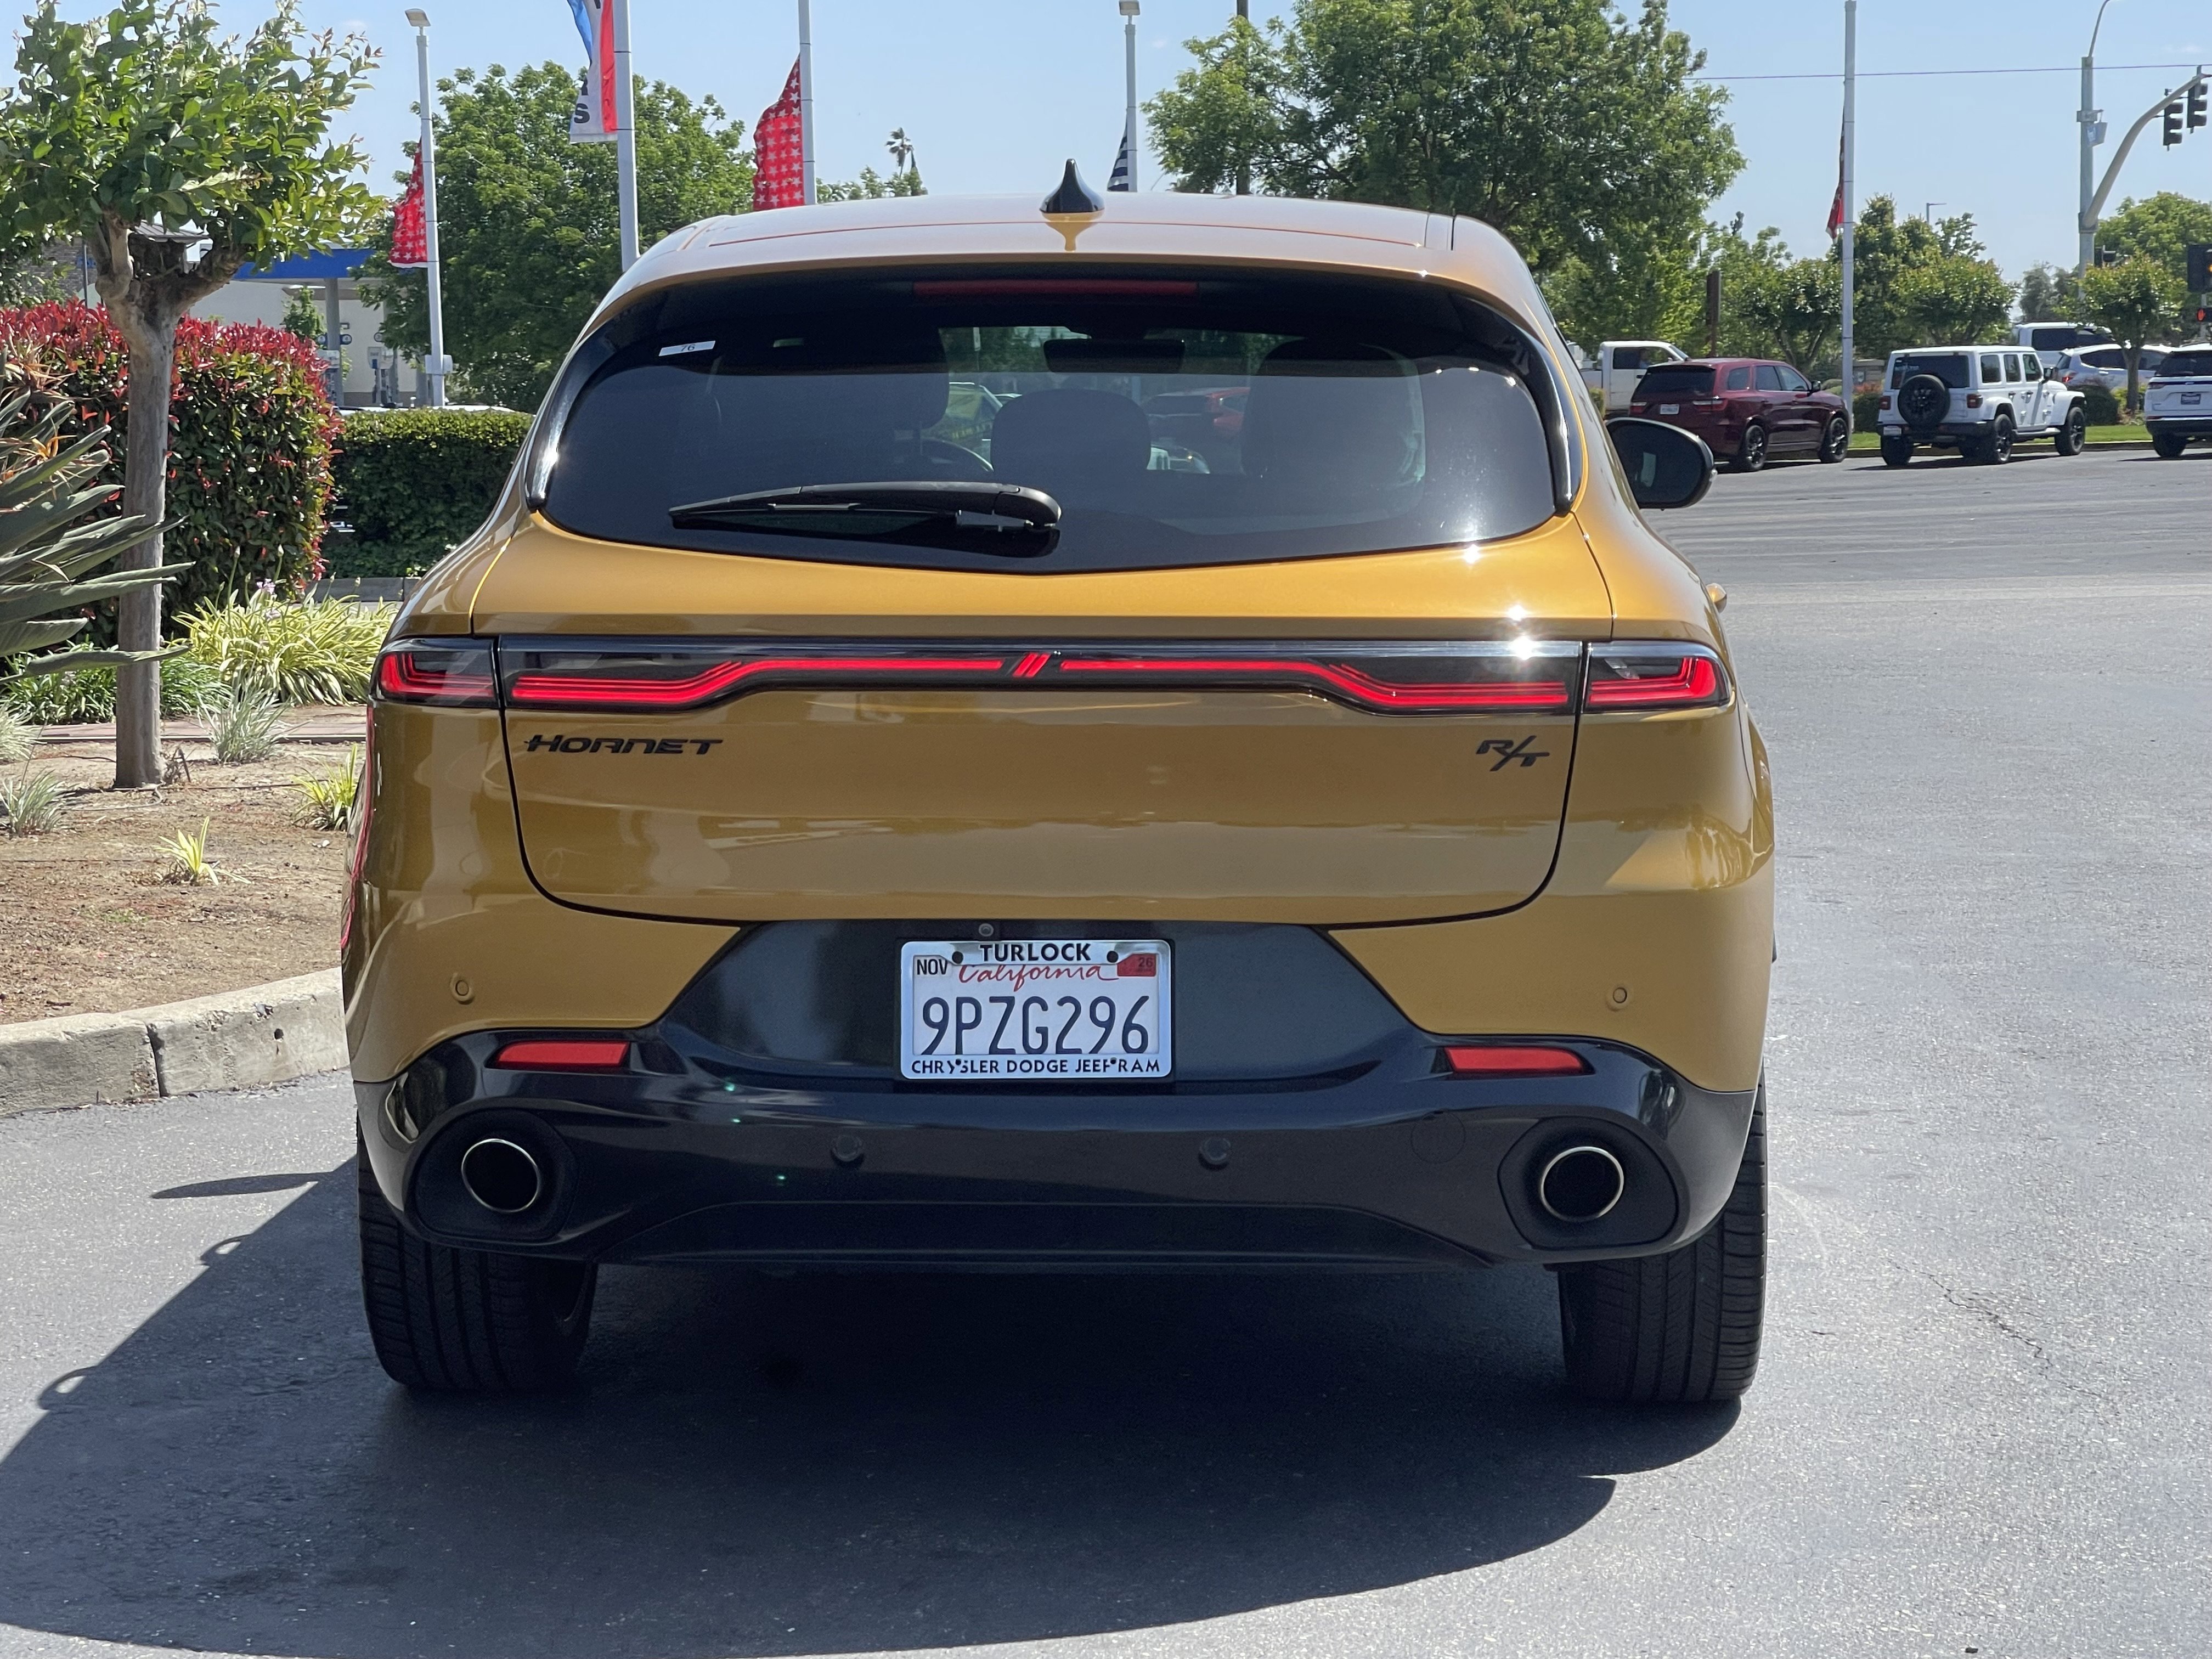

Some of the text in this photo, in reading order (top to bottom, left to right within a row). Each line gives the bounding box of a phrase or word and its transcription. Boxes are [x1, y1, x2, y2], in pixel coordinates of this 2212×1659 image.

[524, 734, 724, 755] HORNET
[1476, 735, 1550, 772] R/T
[980, 943, 1092, 962] TURLOCK
[917, 958, 948, 975] NOV
[958, 964, 1120, 992] California
[921, 996, 1150, 1056] 9PZG296
[1007, 1059, 1068, 1073] DODGE
[1118, 1058, 1160, 1073] RAM
